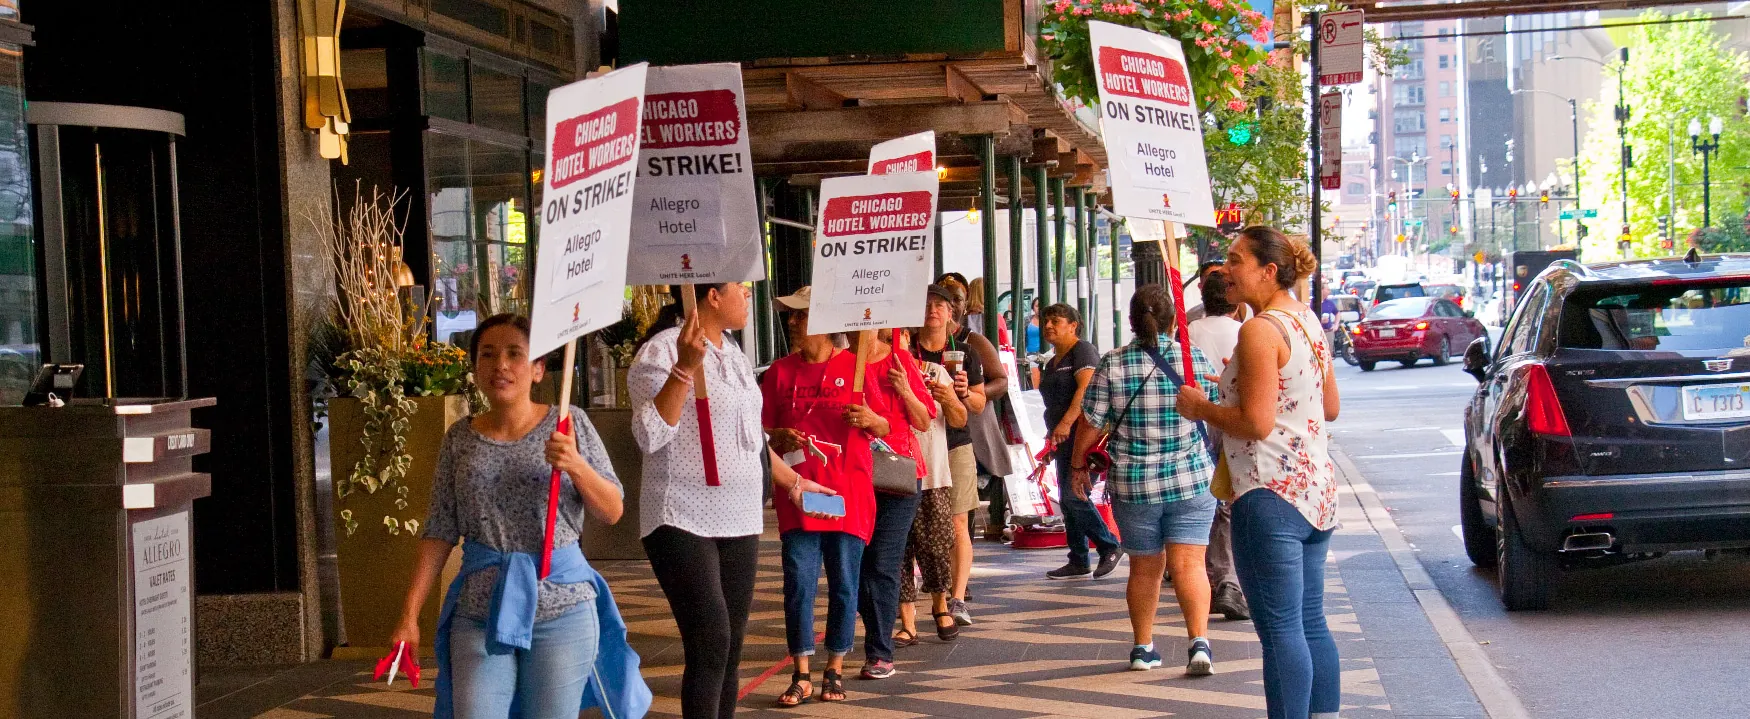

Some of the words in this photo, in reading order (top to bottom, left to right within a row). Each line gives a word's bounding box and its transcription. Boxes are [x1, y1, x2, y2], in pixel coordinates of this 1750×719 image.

[1121, 54, 1165, 78] CHICAGO
[1105, 72, 1140, 94] HOTEL
[1140, 78, 1188, 103] WORKERS
[1325, 75, 1338, 85] TOW
[1341, 72, 1358, 83] ZONE
[642, 98, 699, 120] HICAGO
[1106, 100, 1130, 121] ON
[1134, 104, 1196, 132] STRIKE!
[575, 111, 617, 147] CHICAGO
[659, 120, 736, 143] WORKERS
[554, 151, 585, 183] HOTEL
[588, 133, 634, 170] WORKERS
[1137, 142, 1176, 161] Allegro
[647, 152, 743, 177] STRIKE!
[886, 158, 918, 174] CHICAGO
[1144, 162, 1175, 178] Hotel
[546, 194, 569, 225] ON
[573, 171, 632, 215] STRIKE!
[650, 197, 700, 213] Allegro
[851, 197, 903, 215] CHICAGO
[659, 219, 697, 234] Hotel
[827, 217, 865, 233] HOTEL
[869, 212, 927, 230] WORKERS
[564, 229, 601, 256] Allegro
[821, 241, 847, 258] ON
[853, 235, 927, 255] STRIKE!
[567, 253, 594, 280] Hotel
[679, 271, 694, 279] HERE
[696, 270, 711, 278] Local
[851, 268, 891, 281] Allegro
[854, 283, 885, 296] Hotel
[1694, 396, 1703, 413] C
[1711, 393, 1744, 412] 7373
[144, 539, 181, 565] ALLEGRO
[149, 574, 162, 588] VALET
[163, 570, 176, 584] RATES
